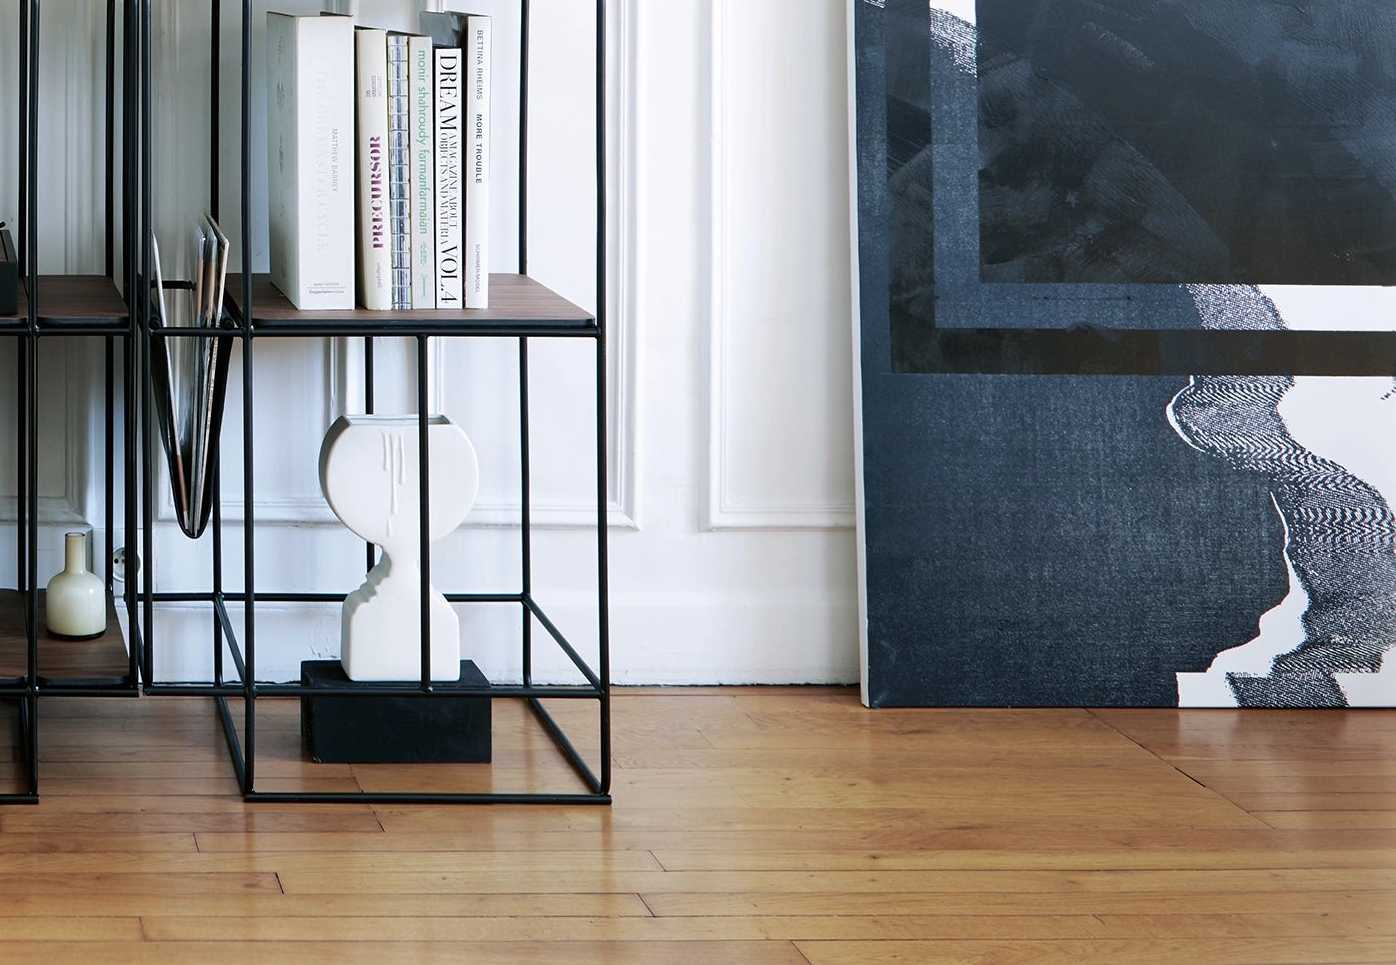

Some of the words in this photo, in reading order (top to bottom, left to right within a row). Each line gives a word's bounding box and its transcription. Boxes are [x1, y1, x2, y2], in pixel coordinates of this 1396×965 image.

[418, 50, 429, 82] monir
[476, 29, 484, 65] BETTINA
[439, 55, 458, 131] DREAM
[476, 67, 484, 100] RHEIMS
[416, 86, 429, 145] shahroudy
[475, 113, 483, 140] MORE
[331, 128, 339, 164] MATTHEW
[439, 132, 448, 175] OBJECTS
[475, 143, 483, 184] TROUBLE
[331, 165, 339, 192] BARNEY
[449, 141, 458, 193] MAGAZINE
[369, 136, 384, 249] PRECURSOR
[418, 149, 431, 235] farmanfarmaian
[440, 176, 449, 199] AND
[449, 195, 458, 229] ABOUT
[440, 244, 458, 304] VOL.4
